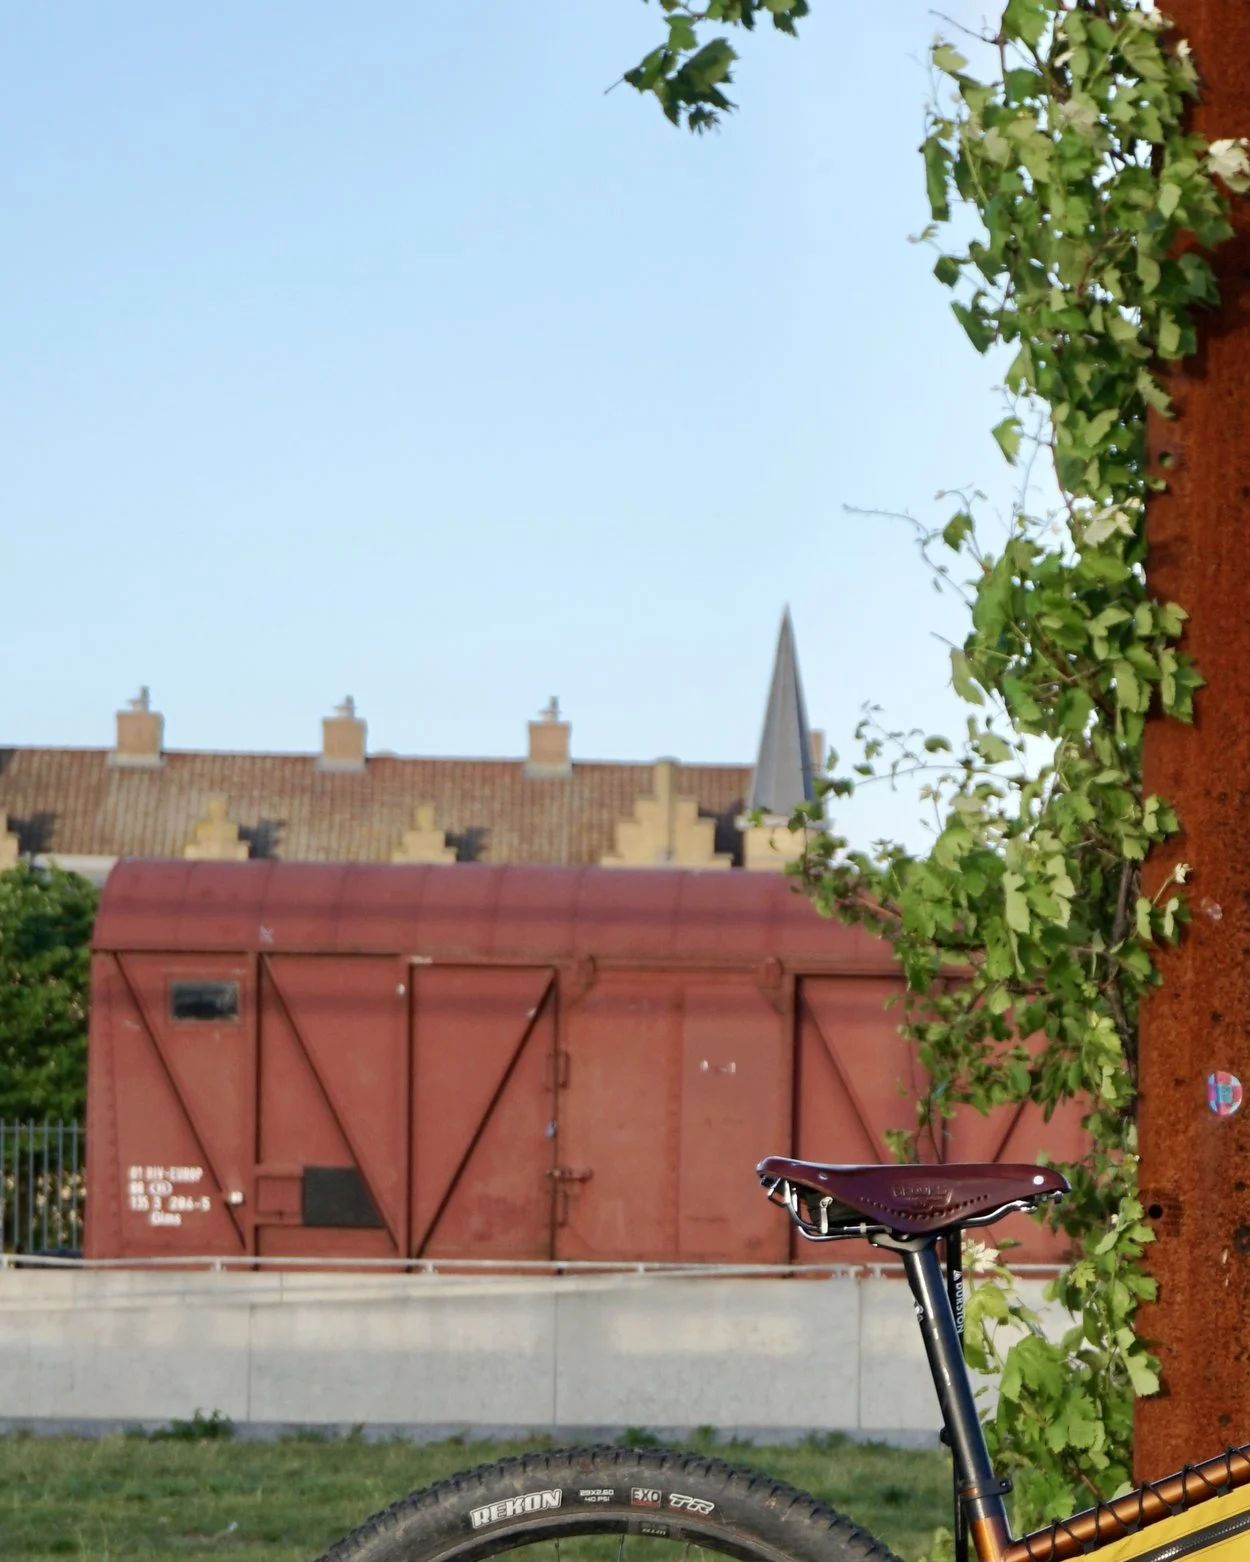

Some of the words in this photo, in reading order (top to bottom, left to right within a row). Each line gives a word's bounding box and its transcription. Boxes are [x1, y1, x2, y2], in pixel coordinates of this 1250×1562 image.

[469, 1489, 563, 1529] REKON
[632, 1488, 661, 1503] EXO
[669, 1493, 715, 1515] TR
